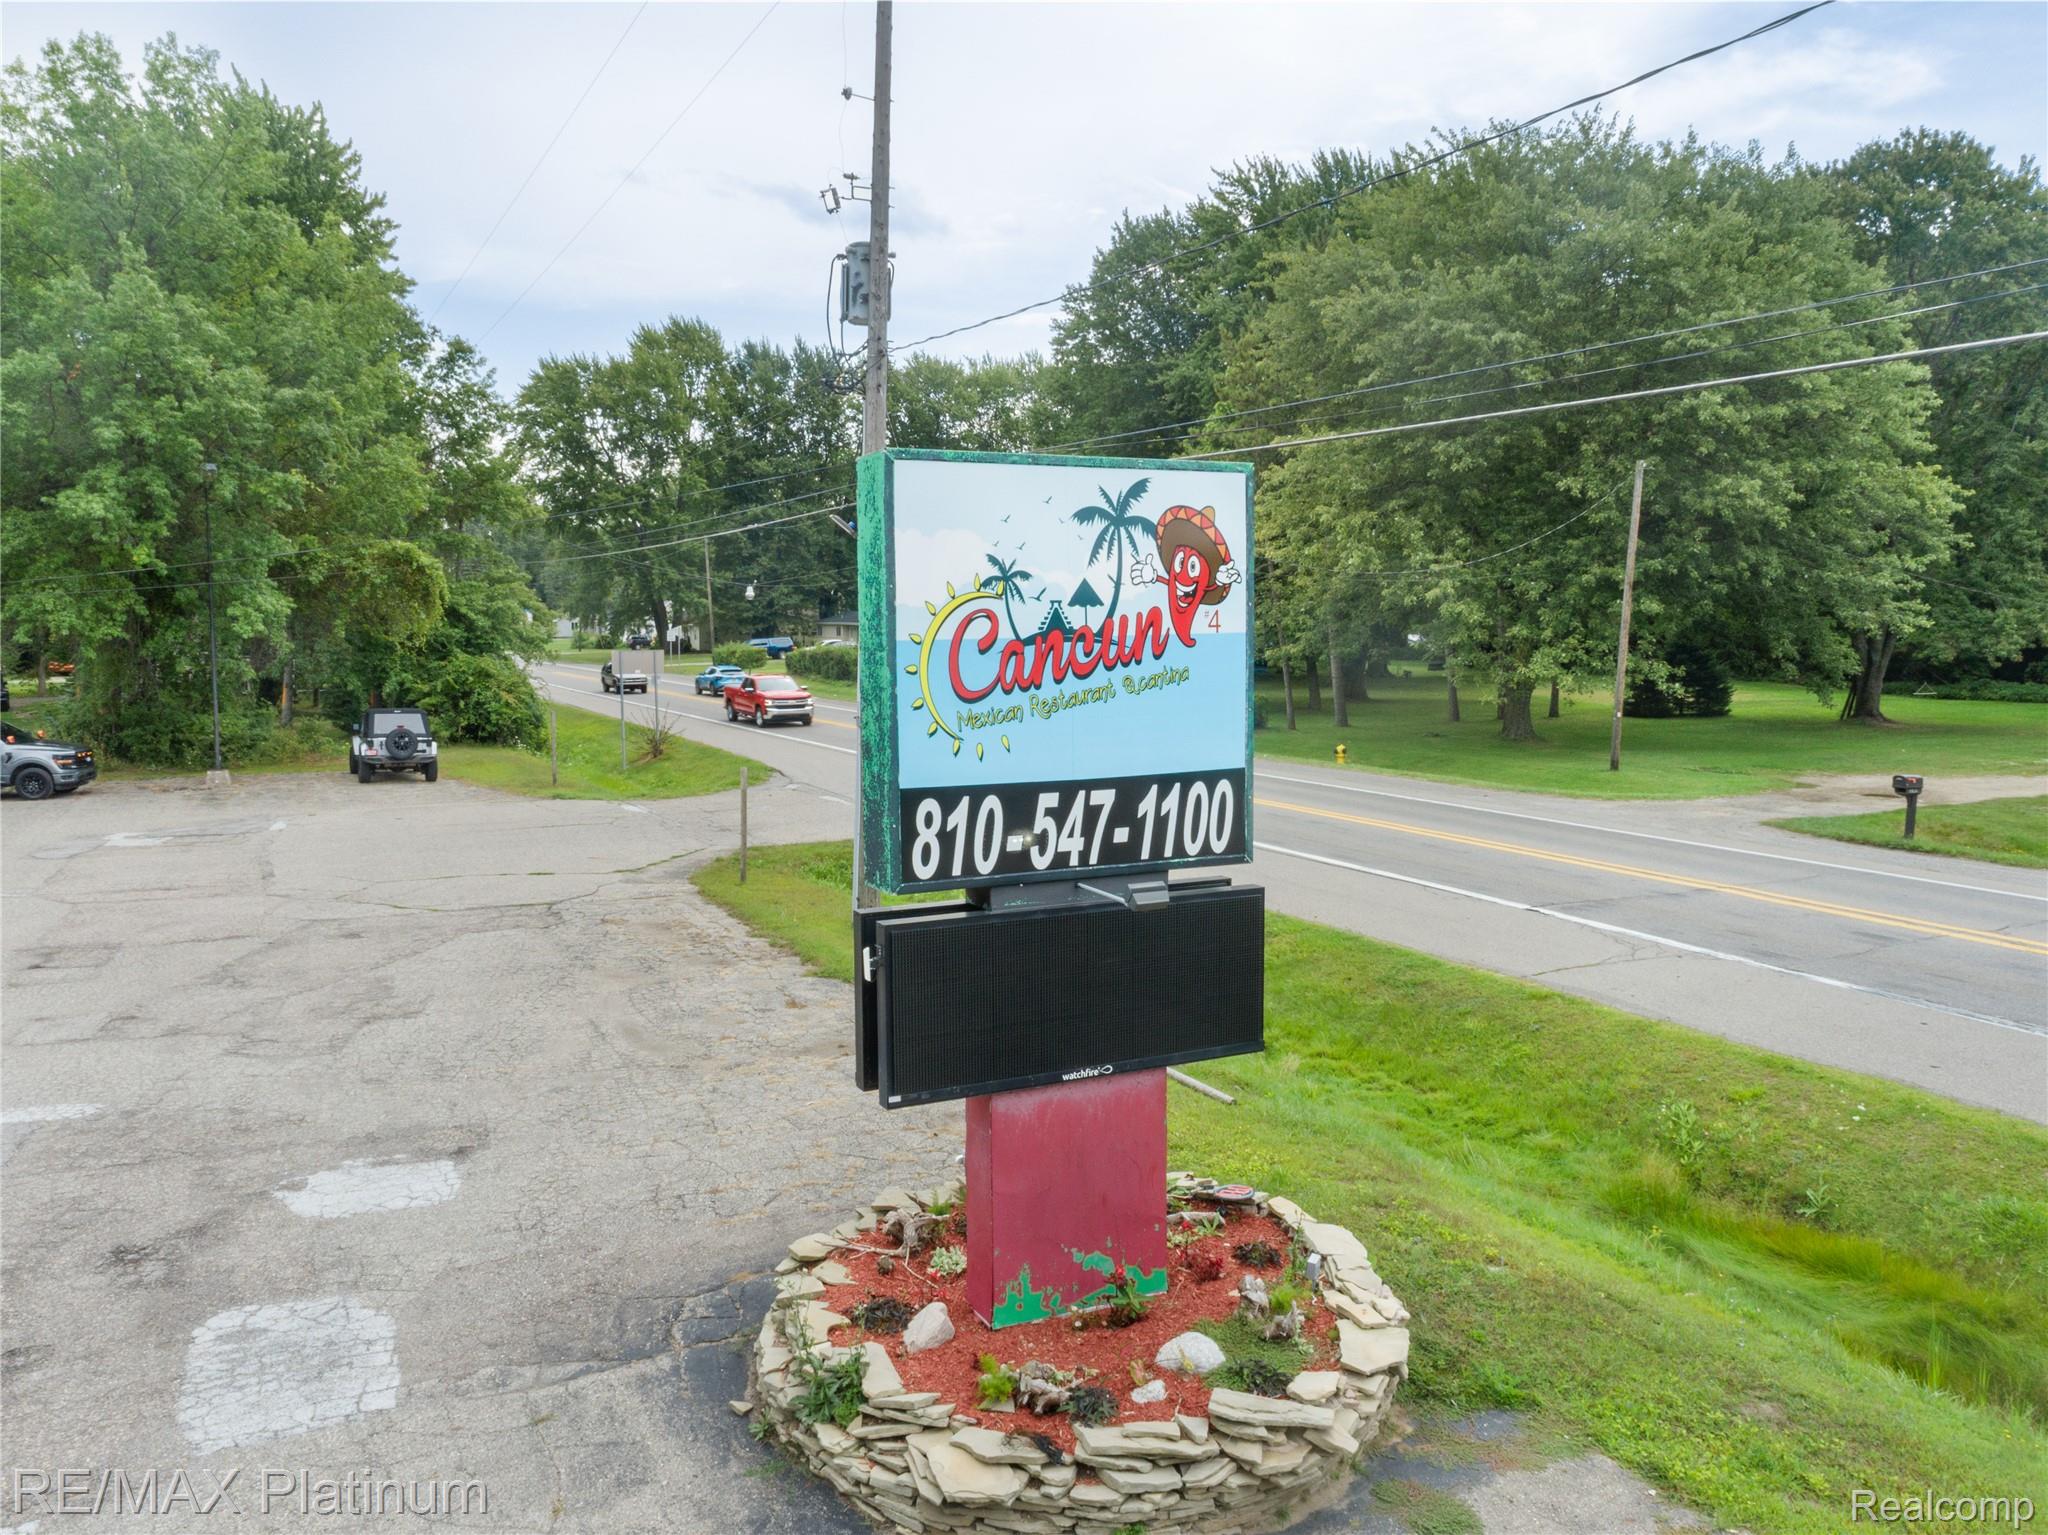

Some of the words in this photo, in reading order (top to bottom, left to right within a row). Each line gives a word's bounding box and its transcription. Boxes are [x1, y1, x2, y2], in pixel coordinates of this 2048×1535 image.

[948, 607, 1171, 704] Cancun
[957, 705, 1023, 732] Mexican
[1030, 678, 1117, 720] Restaurant
[911, 779, 1235, 880] 810-547-1100
[1062, 1068, 1099, 1081] watchfire
